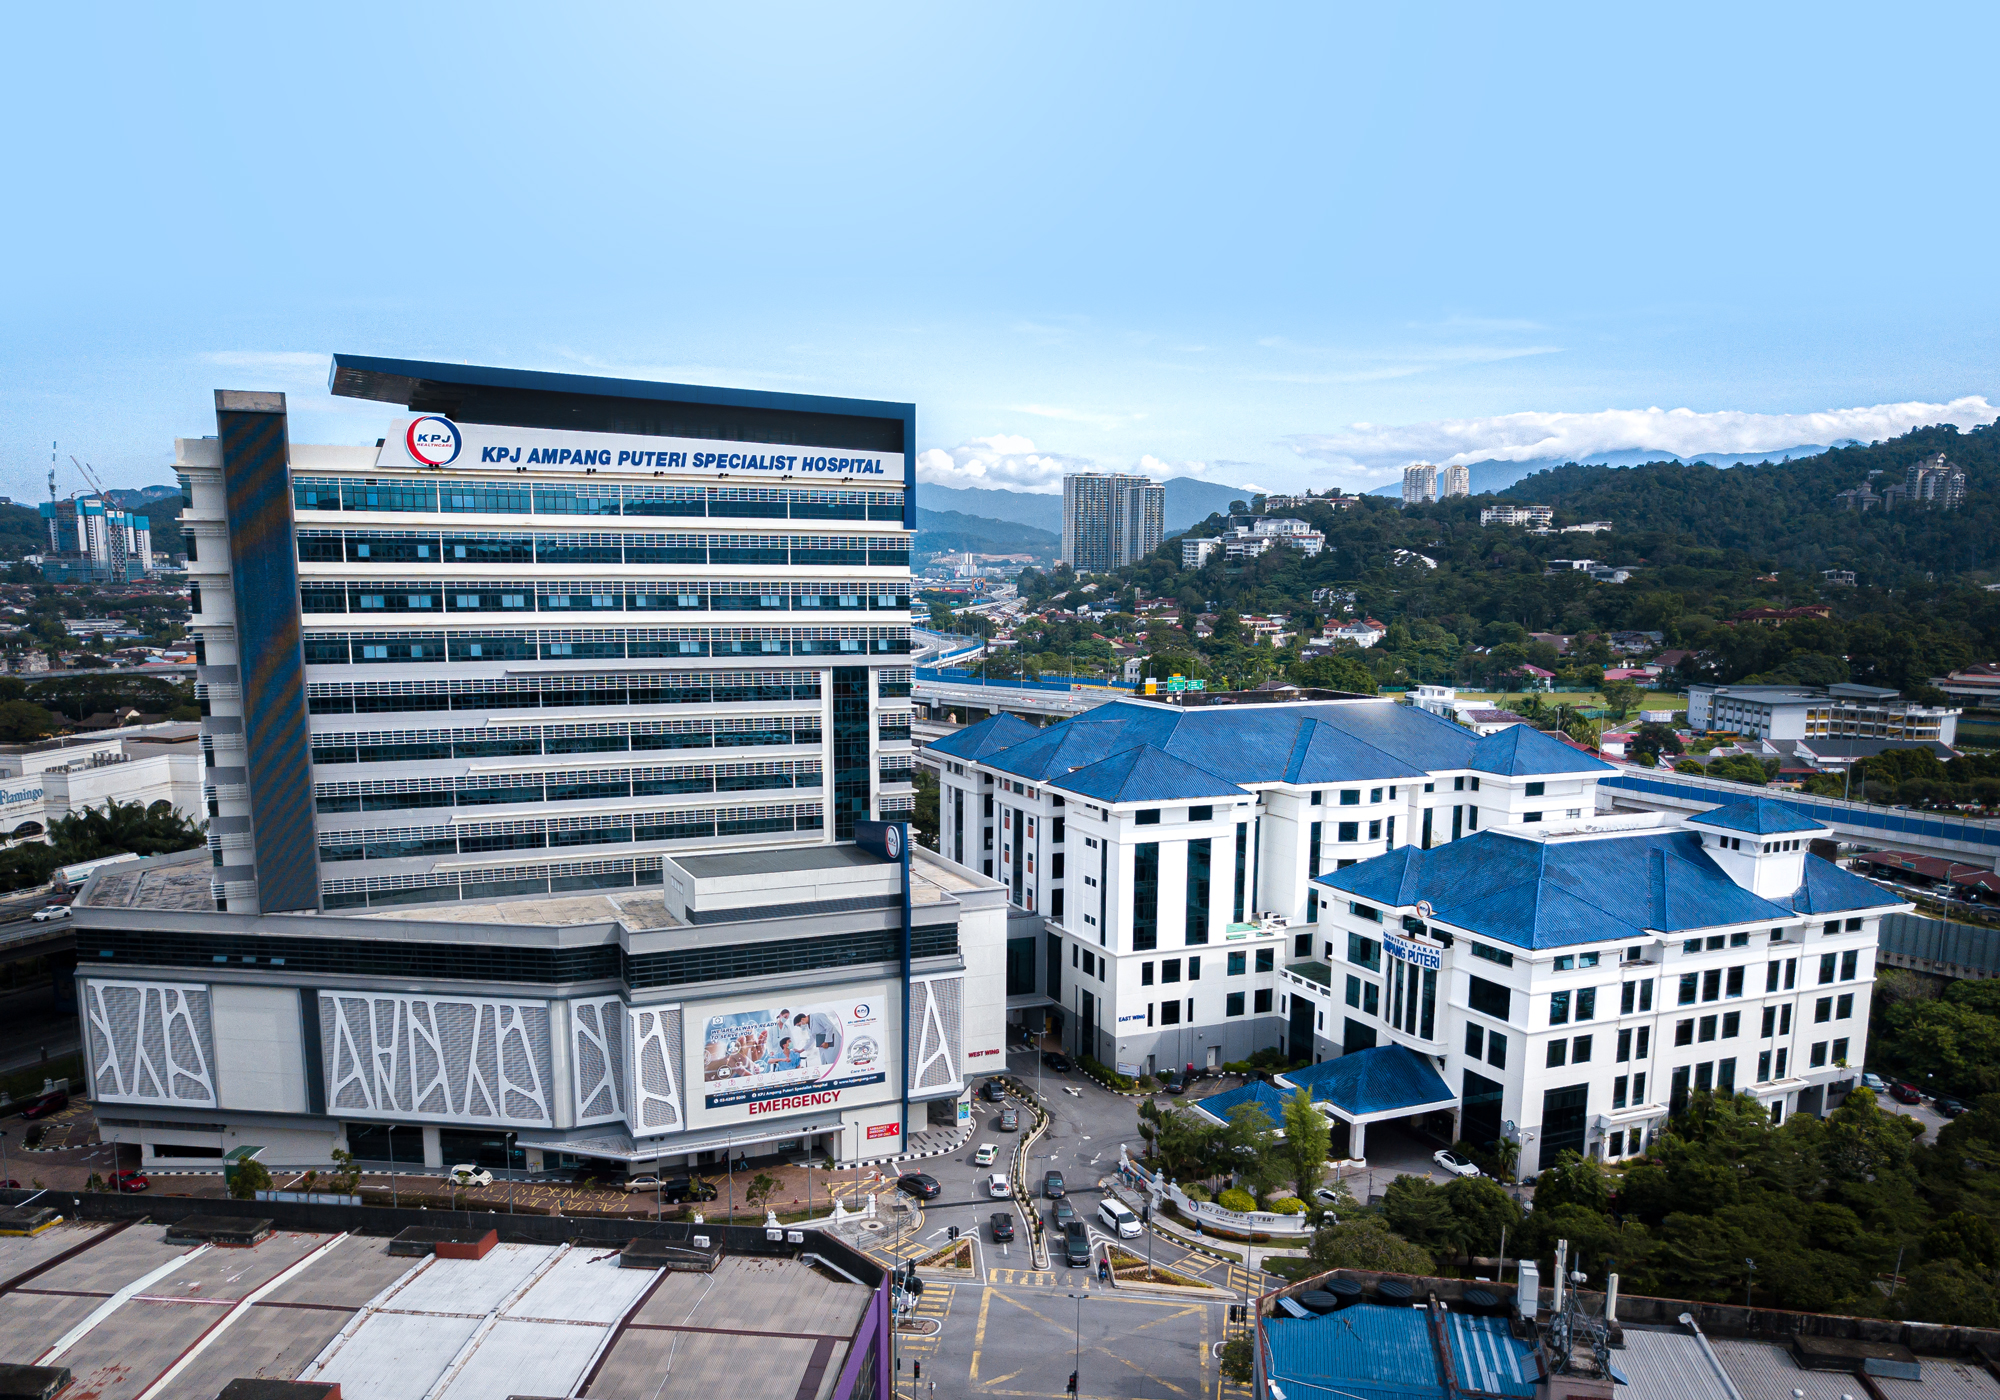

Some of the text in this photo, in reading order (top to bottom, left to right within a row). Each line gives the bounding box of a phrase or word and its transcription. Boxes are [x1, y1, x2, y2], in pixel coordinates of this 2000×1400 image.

[417, 434, 451, 443] KPJ
[481, 446, 884, 474] KPJ AMPANG PUTERI SPECIALIST HOSPITAL
[0, 788, 43, 805] Flamingo
[1383, 931, 1440, 955] HOSPITAL PAKAR
[1383, 938, 1440, 969] AMPANG PUTERI
[968, 1048, 1000, 1058] WEST WING
[749, 1090, 841, 1115] EMERGENCY
[1201, 1204, 1212, 1212] KPJ
[1215, 1209, 1244, 1219] AMPANG
